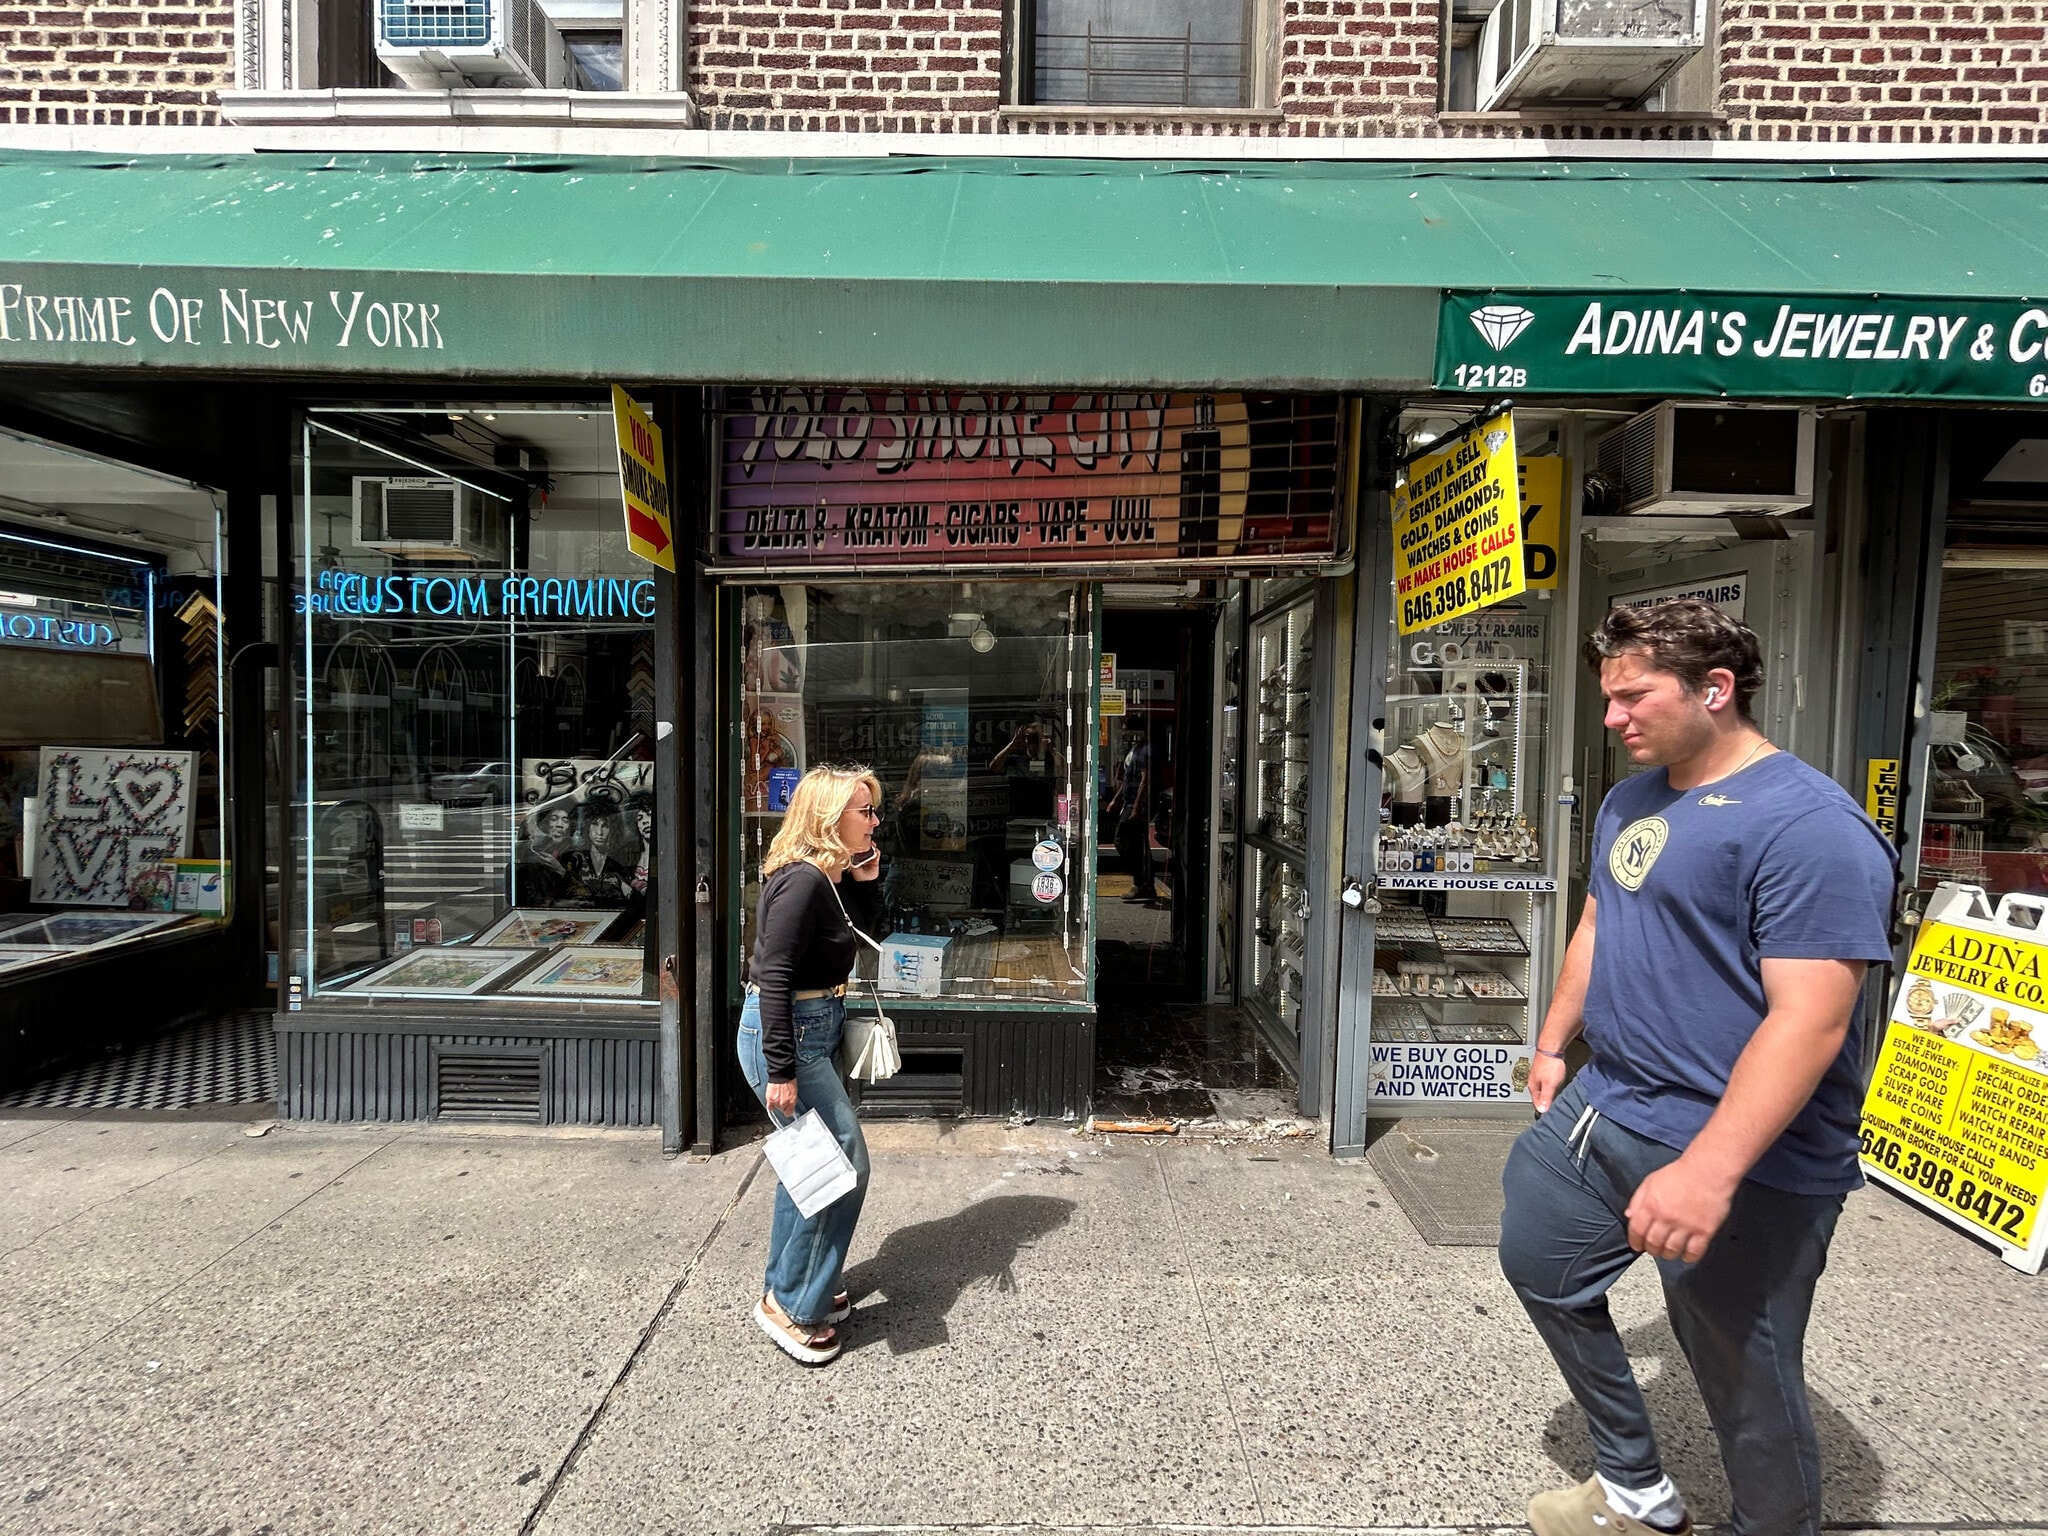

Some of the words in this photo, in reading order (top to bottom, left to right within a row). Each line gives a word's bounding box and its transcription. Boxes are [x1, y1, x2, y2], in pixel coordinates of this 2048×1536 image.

[149, 287, 204, 346] OF
[219, 288, 313, 349] NEW
[330, 291, 444, 349] YORK
[1564, 302, 1747, 357] ADINA'S
[1753, 304, 1968, 360] JEWELRY
[1969, 323, 1994, 362] &
[1454, 363, 1527, 388] 1212B
[2029, 373, 2048, 397] 6
[628, 414, 655, 467] YOLO
[740, 386, 871, 476] YOLO
[876, 387, 1056, 475] SMOKE
[1066, 388, 1171, 471] CITY
[620, 447, 650, 507] SMOKE
[648, 471, 668, 518] SHOP
[1408, 479, 1423, 501] WE
[1424, 464, 1443, 492] BUY
[1446, 459, 1455, 477] &
[1456, 441, 1480, 471] SELL
[1409, 491, 1441, 524] ESTATE
[1443, 459, 1488, 504] JEWELRY
[743, 508, 808, 550] DELTA
[844, 505, 930, 548] KRATOM
[946, 503, 1021, 546] CIGARS
[1038, 500, 1090, 544] VAPE
[1104, 498, 1155, 543] JUUL
[1400, 522, 1432, 550] GOLD,
[1435, 479, 1504, 532] DIAMONDS,
[1398, 575, 1412, 594] WE
[1414, 561, 1441, 587] MAKE
[1443, 542, 1478, 574] HOUSE
[1481, 523, 1515, 556] CALLS
[1407, 531, 1451, 569] WATCHES
[1453, 527, 1462, 546] &
[1463, 505, 1499, 540] COINS
[339, 577, 490, 617] CUSTOM
[501, 577, 655, 617] FRAMING
[1404, 556, 1512, 627] 646.398.8472
[1391, 877, 1438, 889] MAKE
[1443, 879, 1499, 890] HOUSE
[1503, 880, 1555, 891] CALLS
[1938, 934, 2043, 979] ADINA
[1913, 954, 1993, 988] JEWELRY
[1994, 976, 2010, 994] &
[2014, 981, 2046, 1005] CO.
[1372, 1047, 1402, 1063] WE
[1408, 1048, 1447, 1063] BUY
[1453, 1048, 1513, 1066] GOLD,
[1893, 1037, 1920, 1055] ESTATE
[1912, 1033, 1925, 1046] WE
[1926, 1038, 1943, 1052] BUY
[1392, 1064, 1495, 1081] DIAMONDS
[1888, 1063, 1918, 1082] SCRAP
[1919, 1076, 1948, 1096] GOLD
[1895, 1051, 1949, 1081] DIAMONDS
[1988, 1061, 2000, 1073] WE
[2000, 1066, 2041, 1088] SPECIALIZE
[1374, 1081, 1415, 1096] AND
[1422, 1082, 1512, 1098] WATCHES
[1876, 1087, 1883, 1098] &
[1885, 1091, 1909, 1110] RARE
[1910, 1103, 1943, 1125] COINS
[1883, 1075, 1914, 1096] SILVER
[1916, 1089, 1944, 1110] WARE
[1971, 1085, 2015, 1110] JEWELRY
[2016, 1103, 2048, 1125] REPAI
[1975, 1070, 2014, 1095] SPECIAL
[2017, 1086, 2048, 1107] ORDE
[1959, 1110, 1995, 1134] WATCH
[1996, 1127, 2048, 1160] BATTERIES
[1971, 1099, 2007, 1124] WATCH
[2008, 1116, 2046, 1140] REPAIR
[1862, 1111, 1908, 1140] LIQUIDATION
[1907, 1134, 1941, 1158] BROKER
[1941, 1150, 1957, 1166] FOR
[1959, 1159, 1975, 1176] ALL
[1978, 1168, 2003, 1190] YOUR
[2003, 1181, 2038, 1207] NEEDS
[1900, 1115, 1912, 1129] WE
[1912, 1121, 1936, 1140] MAKE
[1936, 1134, 1967, 1156] HOUSE
[1966, 1146, 1995, 1170] CALLS
[1962, 1127, 1998, 1153] WATCH
[1999, 1145, 2037, 1171] BANDS
[1860, 1128, 2025, 1238] 646.398.8472
